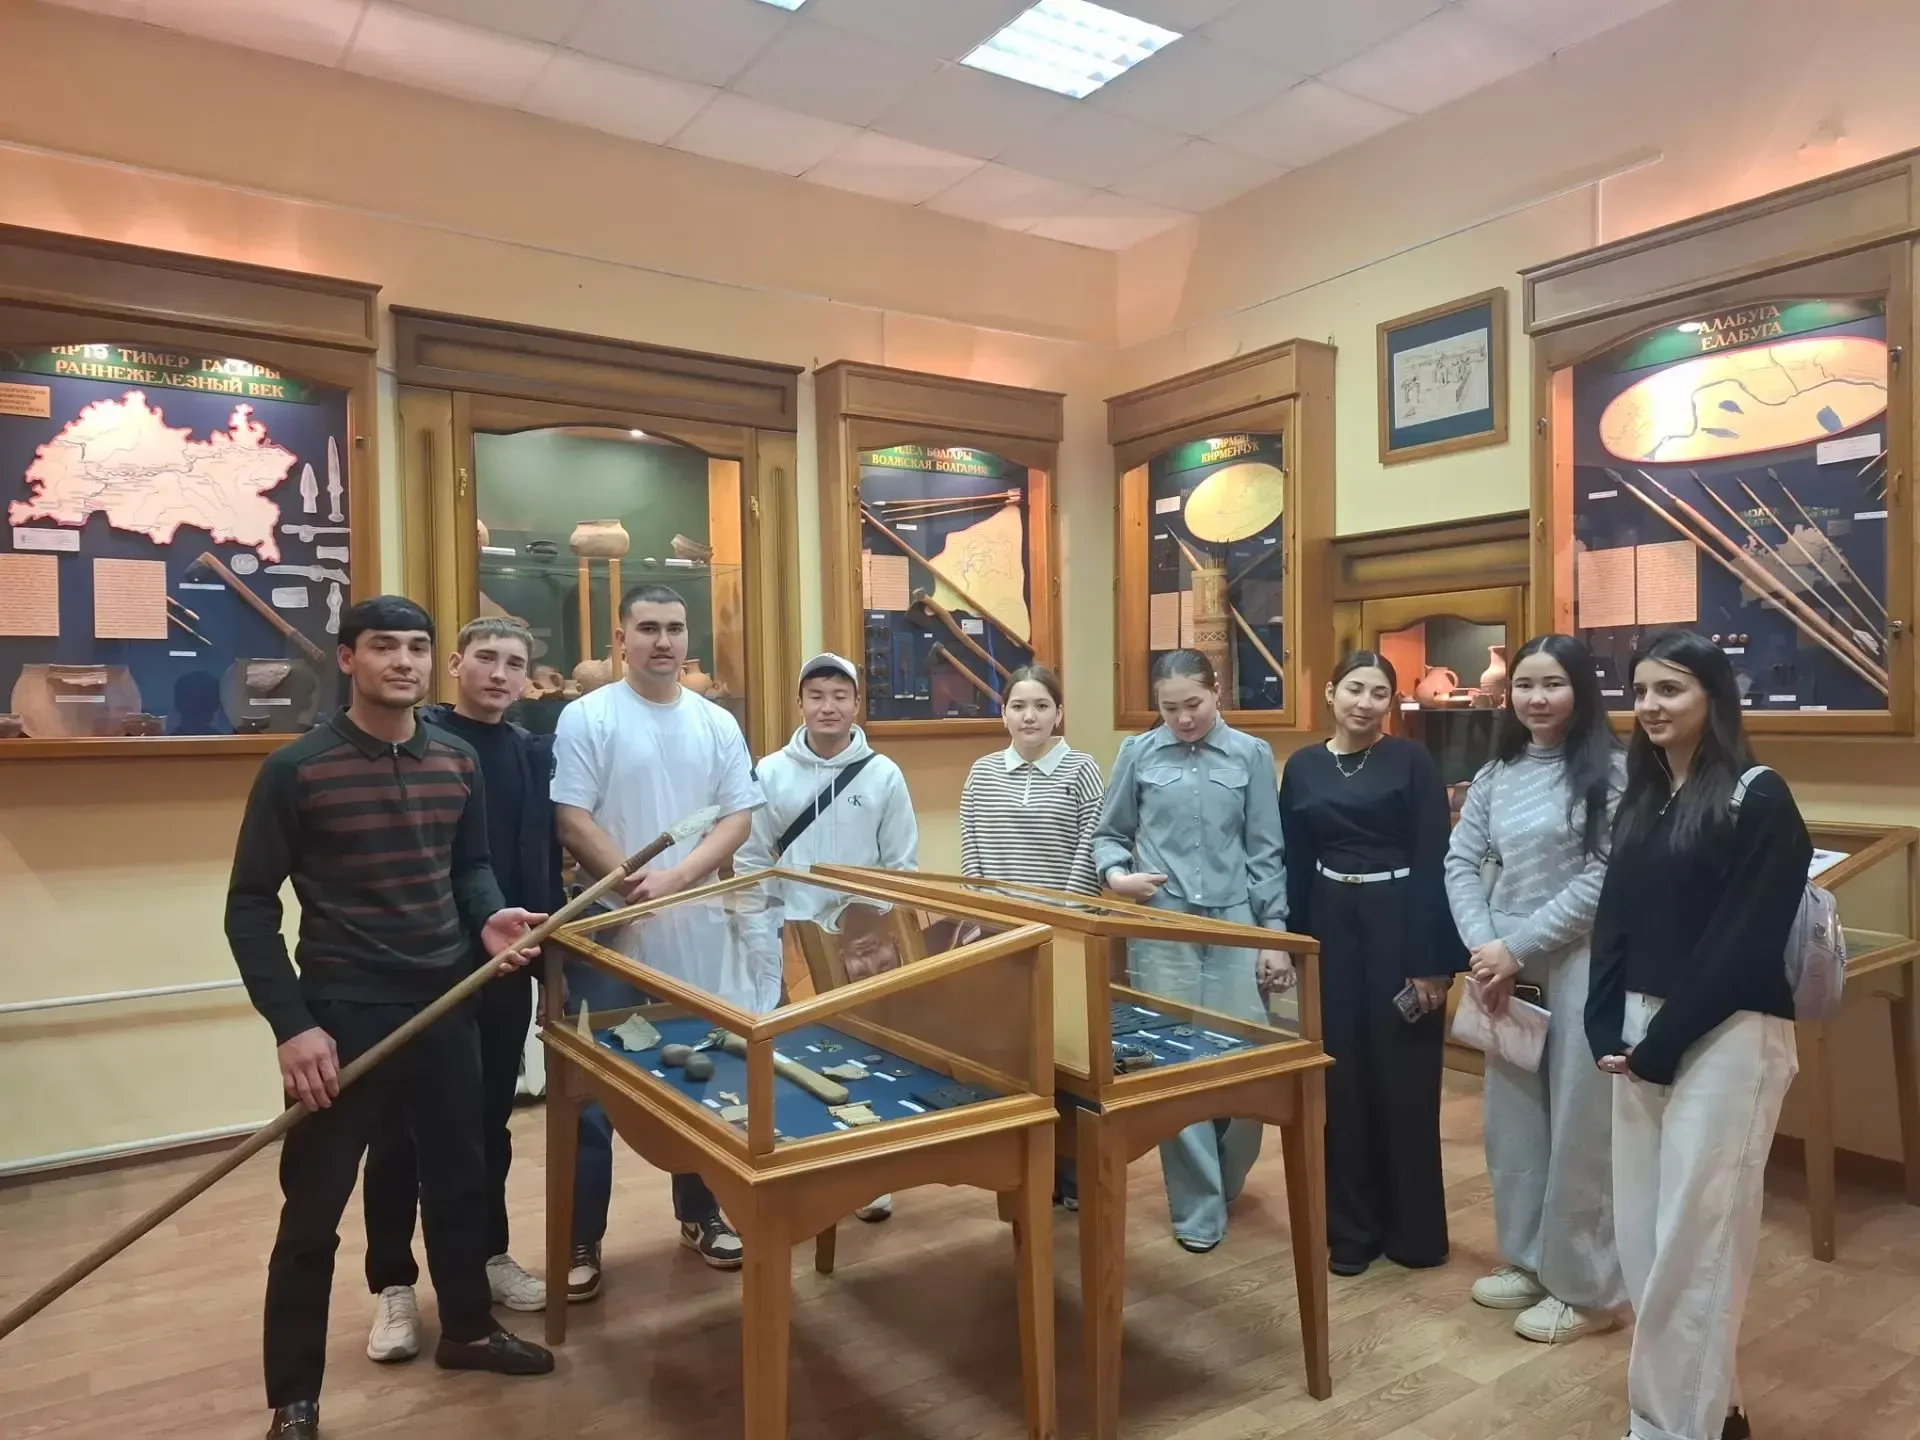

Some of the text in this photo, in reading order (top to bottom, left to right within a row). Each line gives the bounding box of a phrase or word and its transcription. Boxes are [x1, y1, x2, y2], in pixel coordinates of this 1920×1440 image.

[1697, 304, 1781, 336] АЛАБУГА
[1701, 321, 1784, 352] ЕЛАБУГА
[118, 348, 190, 368] ТИМЕР
[55, 359, 285, 398] РАННЕЖЕЛЕЗНЫЙ ВЕК
[872, 453, 988, 475] ВОЛЖСКАЯ БОЛГАРИЯ
[1201, 440, 1260, 463] КИРМЕНЧУК
